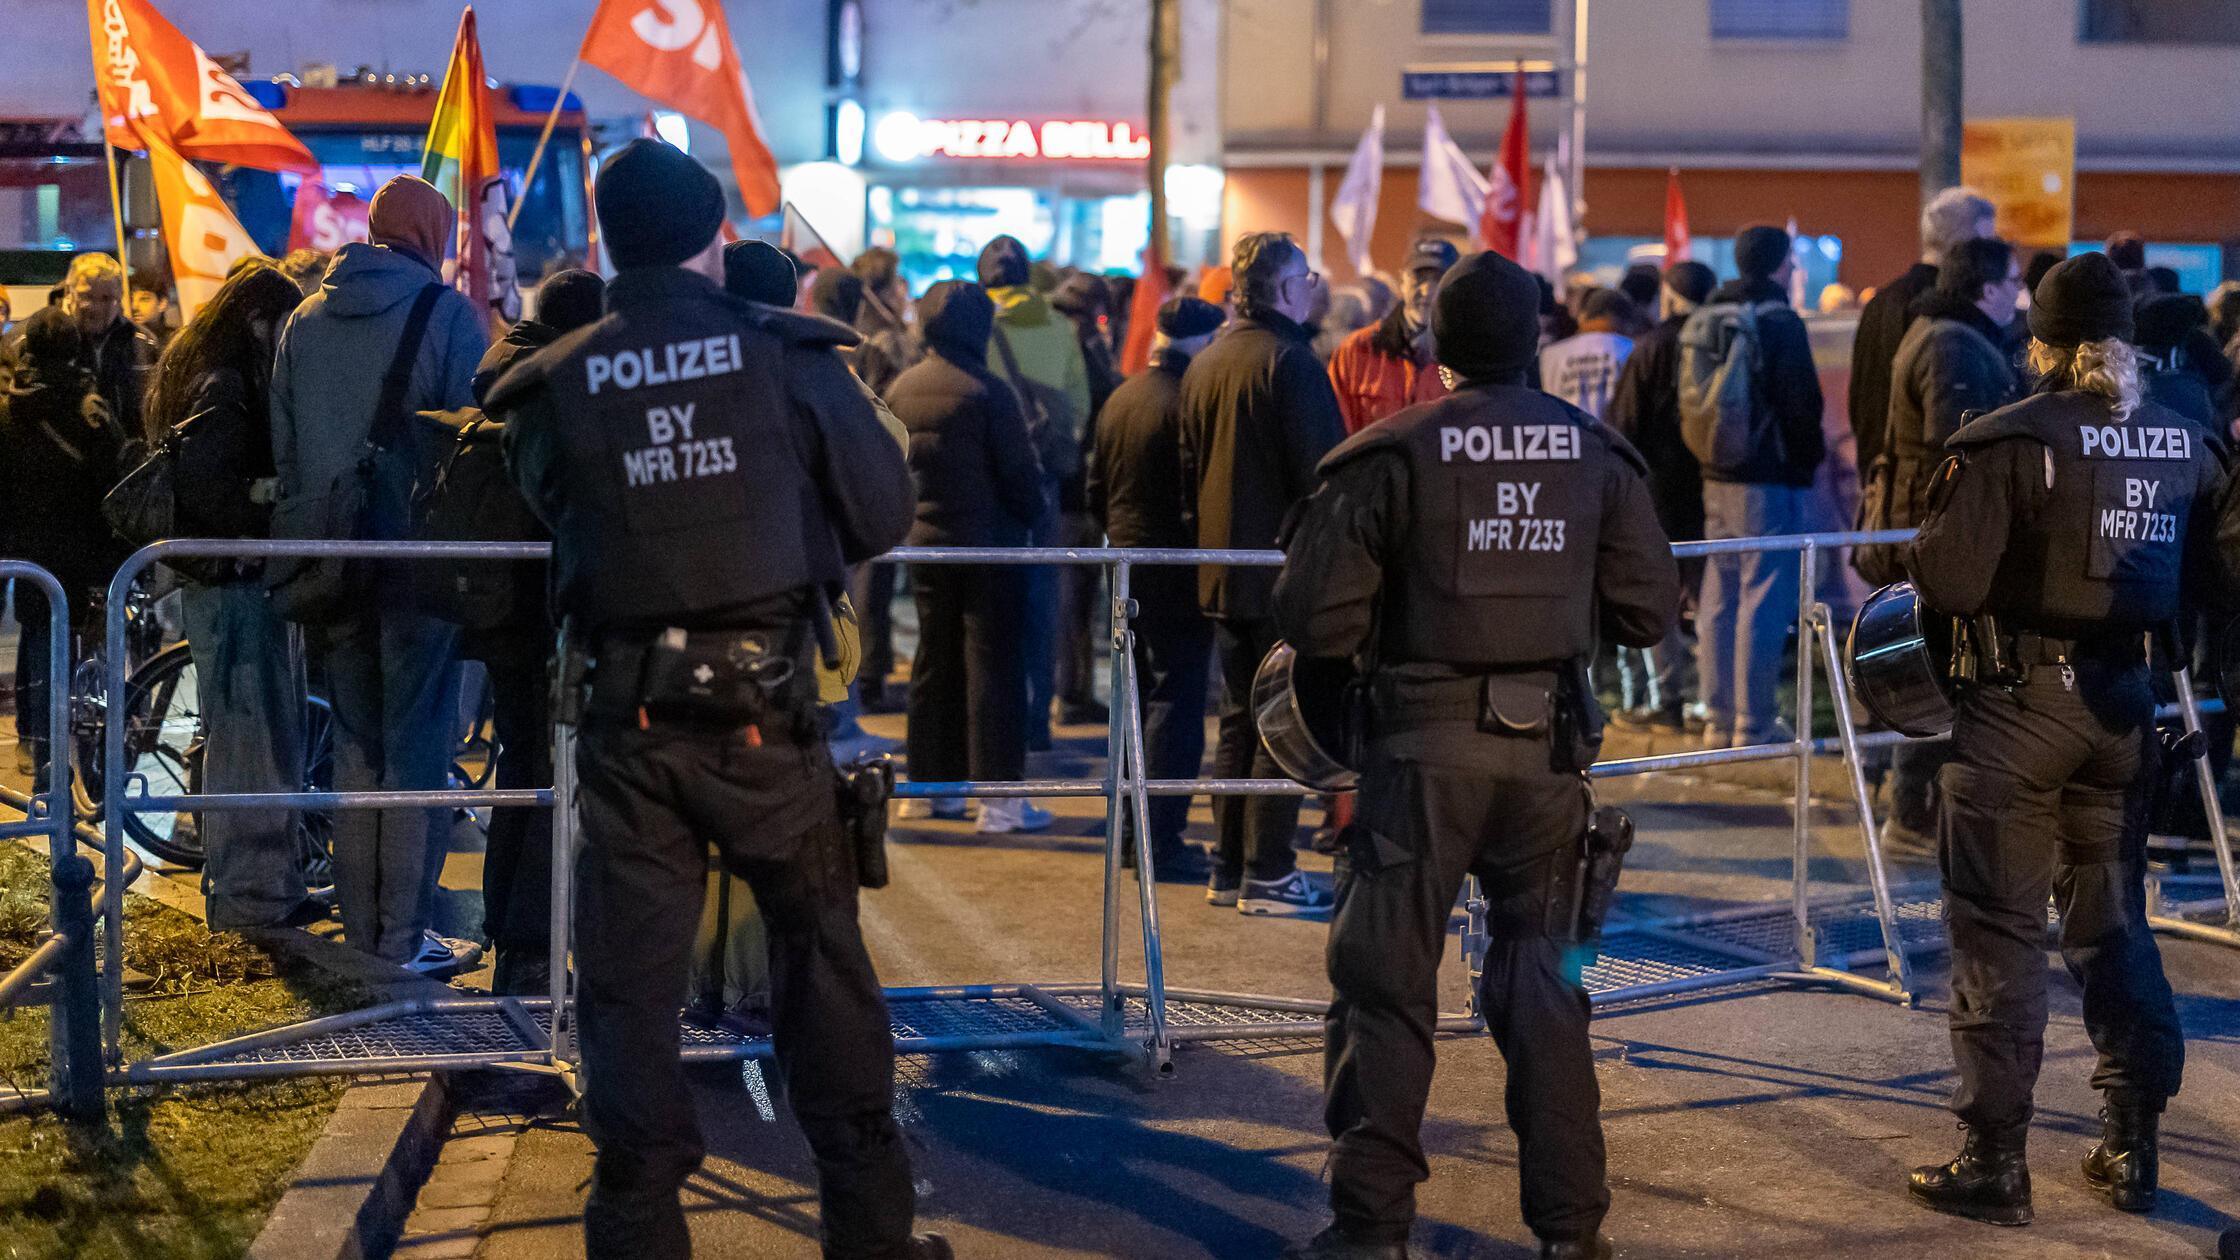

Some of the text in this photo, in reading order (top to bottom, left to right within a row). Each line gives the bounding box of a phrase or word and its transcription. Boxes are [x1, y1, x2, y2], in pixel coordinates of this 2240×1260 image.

[920, 120, 1151, 159] PIZZA BELL
[586, 334, 743, 395] POLIZEI
[647, 403, 696, 445] BY
[1440, 425, 1581, 462] POLIZEI
[2080, 425, 2191, 459] POLIZEI
[623, 437, 738, 488] MFR 7233
[1497, 482, 1541, 515] BY
[2125, 478, 2160, 509] BY
[1468, 519, 1566, 552] MFR 7233
[2100, 509, 2177, 543] MFR 7233
